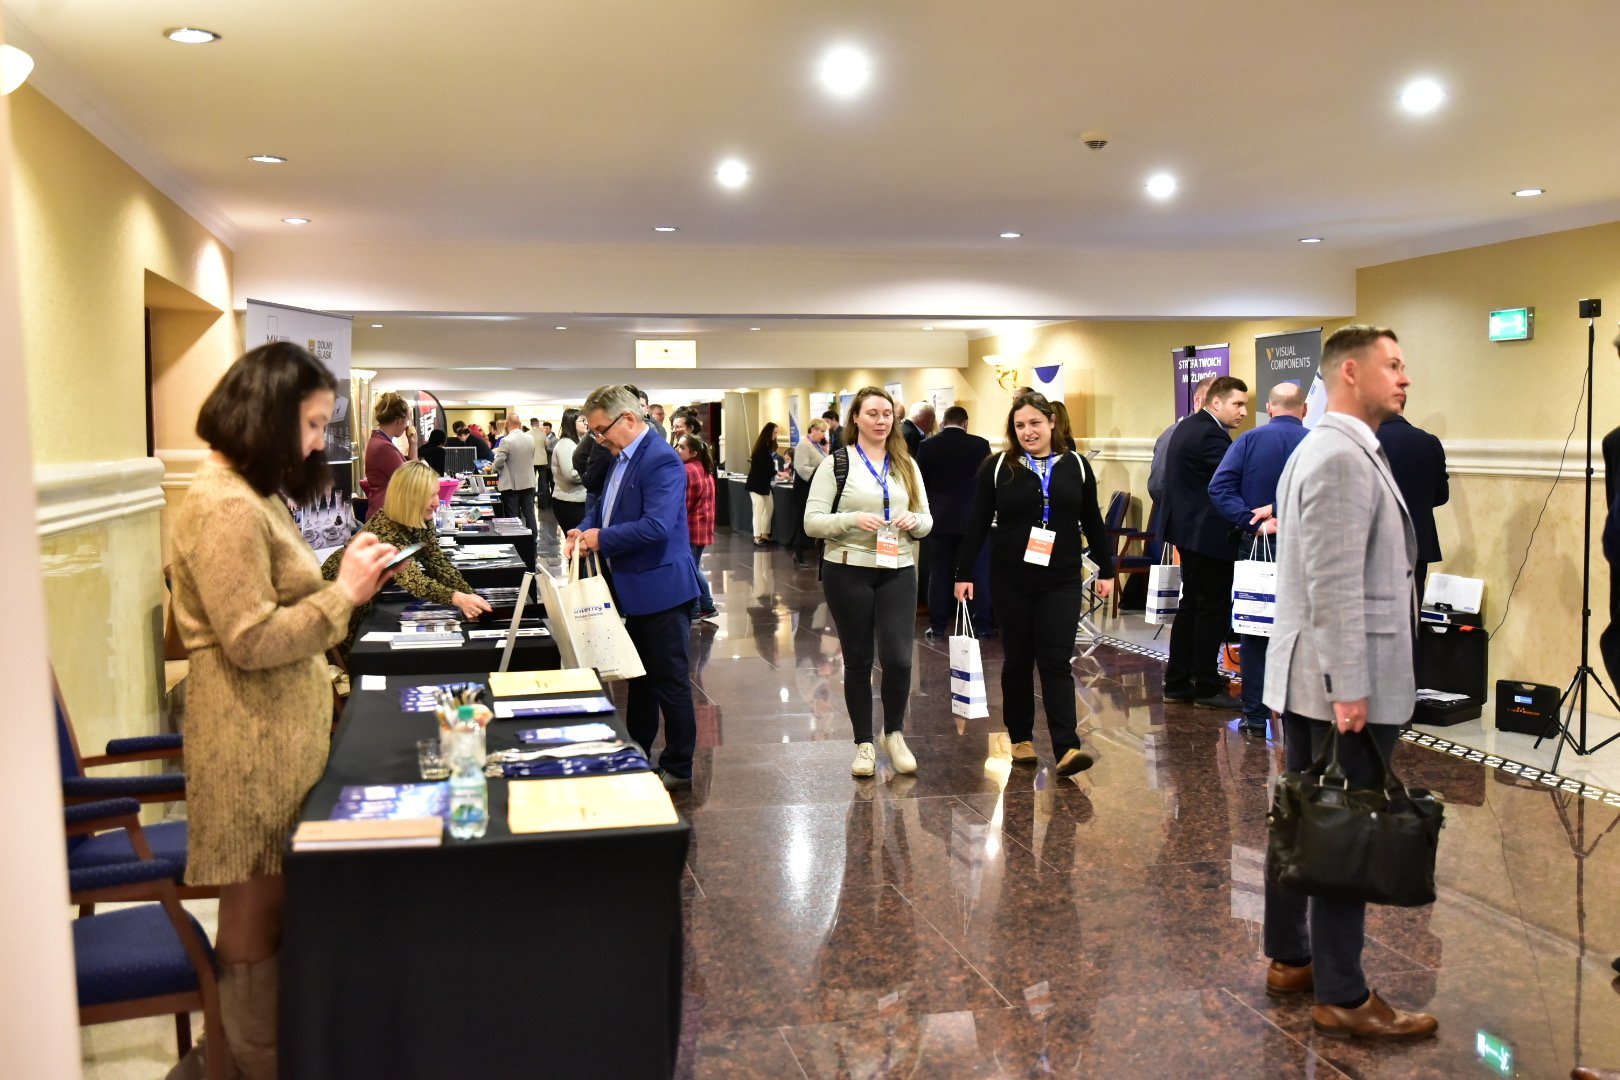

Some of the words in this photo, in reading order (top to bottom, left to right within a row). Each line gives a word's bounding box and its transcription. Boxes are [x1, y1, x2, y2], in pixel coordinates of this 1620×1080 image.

[1276, 345, 1296, 357] VISUAL
[1199, 357, 1222, 368] TWOICH
[1271, 357, 1310, 370] COMPONENTS
